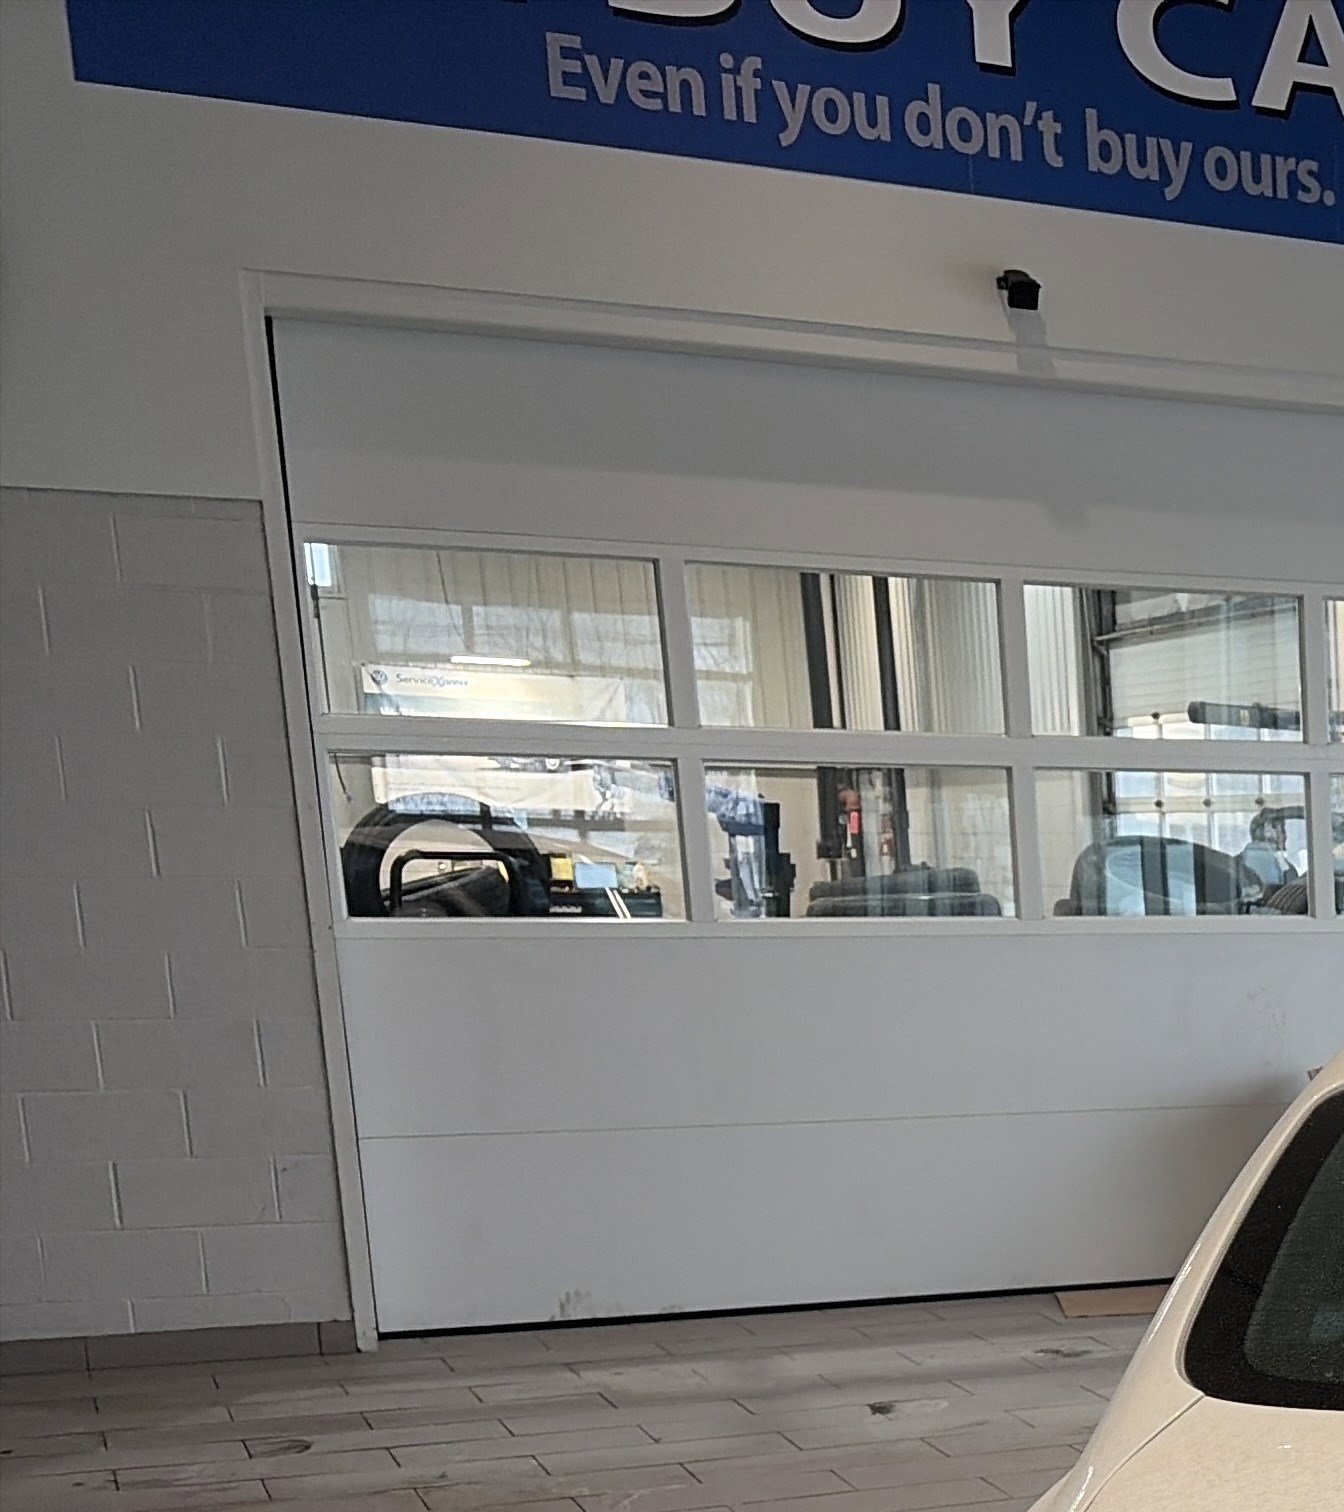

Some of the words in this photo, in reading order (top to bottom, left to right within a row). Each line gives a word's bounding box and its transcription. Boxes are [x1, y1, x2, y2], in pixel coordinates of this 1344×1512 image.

[546, 31, 706, 117] Even
[720, 52, 762, 123] if
[772, 79, 891, 147] you
[904, 83, 1063, 168] don’t
[1086, 108, 1193, 201] buy
[1204, 146, 1337, 206] ours.
